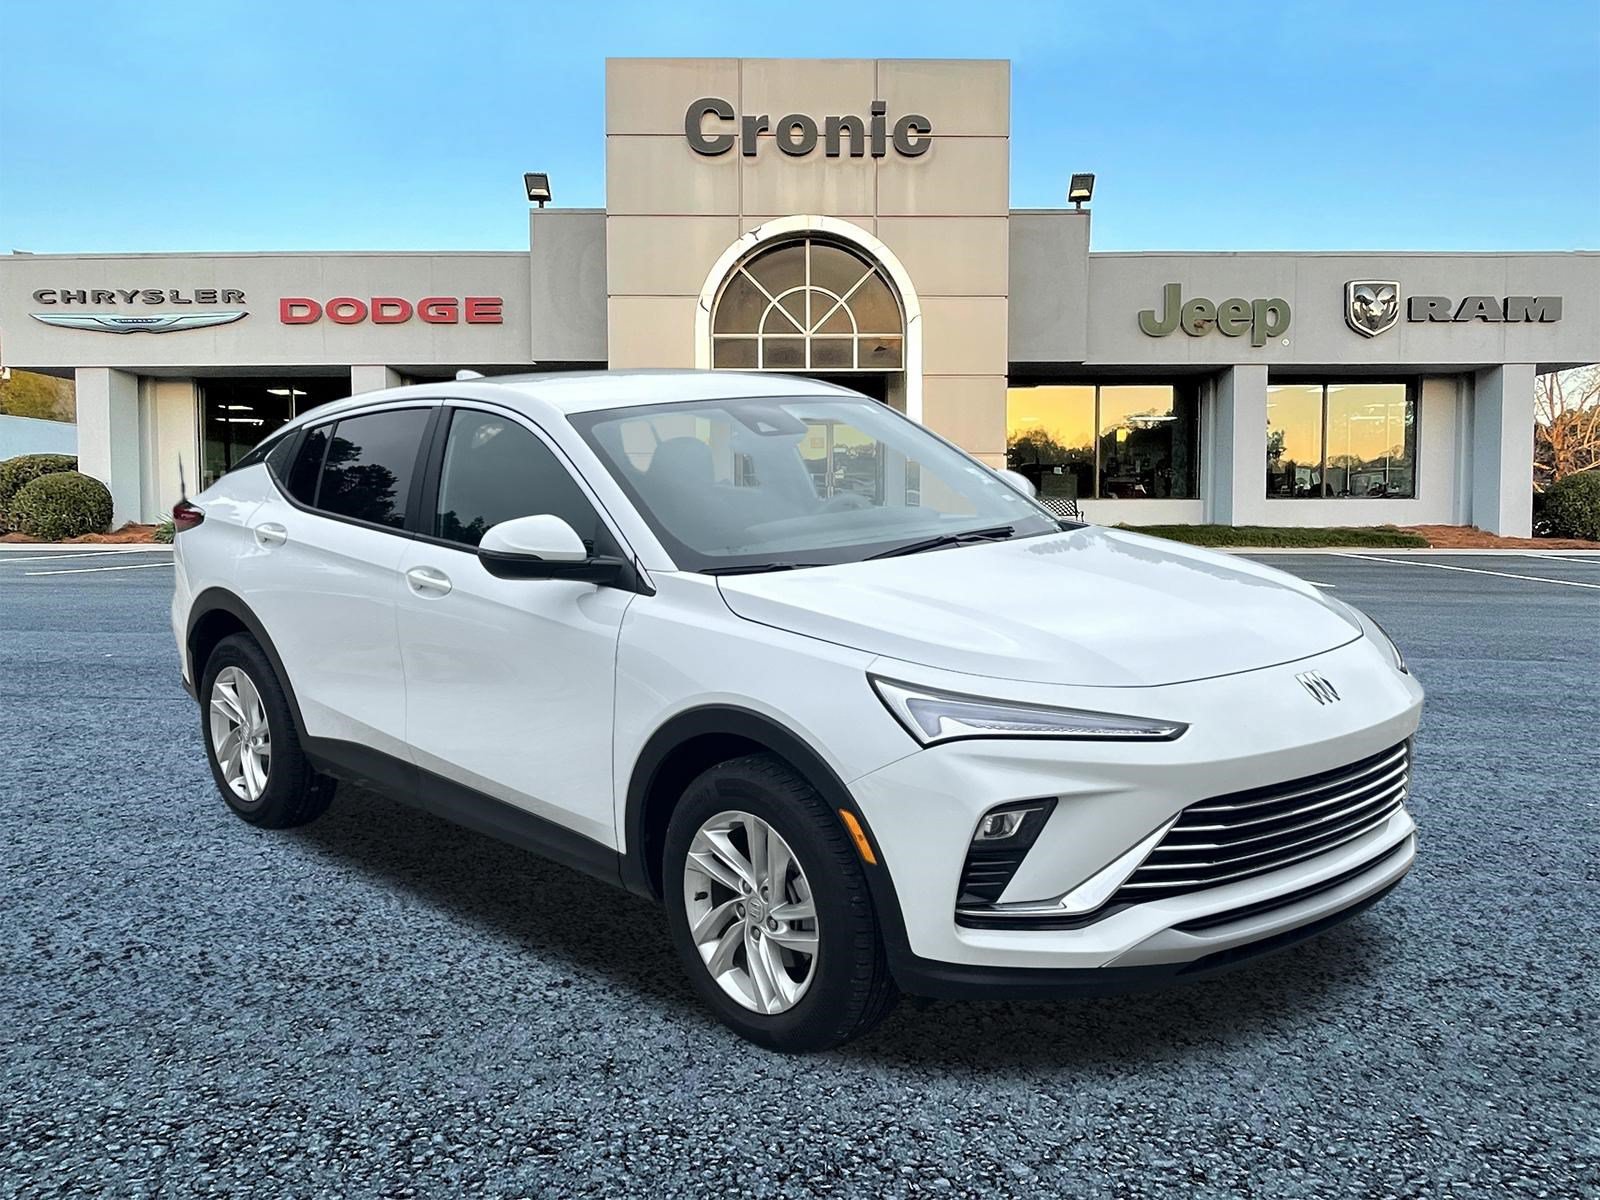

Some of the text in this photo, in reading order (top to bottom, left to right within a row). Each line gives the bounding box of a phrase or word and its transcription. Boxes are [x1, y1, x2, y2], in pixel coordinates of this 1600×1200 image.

[685, 97, 932, 157] Cronic
[33, 288, 246, 305] CHRYSLER
[1407, 296, 1563, 321] RAM
[280, 297, 504, 324] DODGE
[1138, 283, 1291, 347] Jeep
